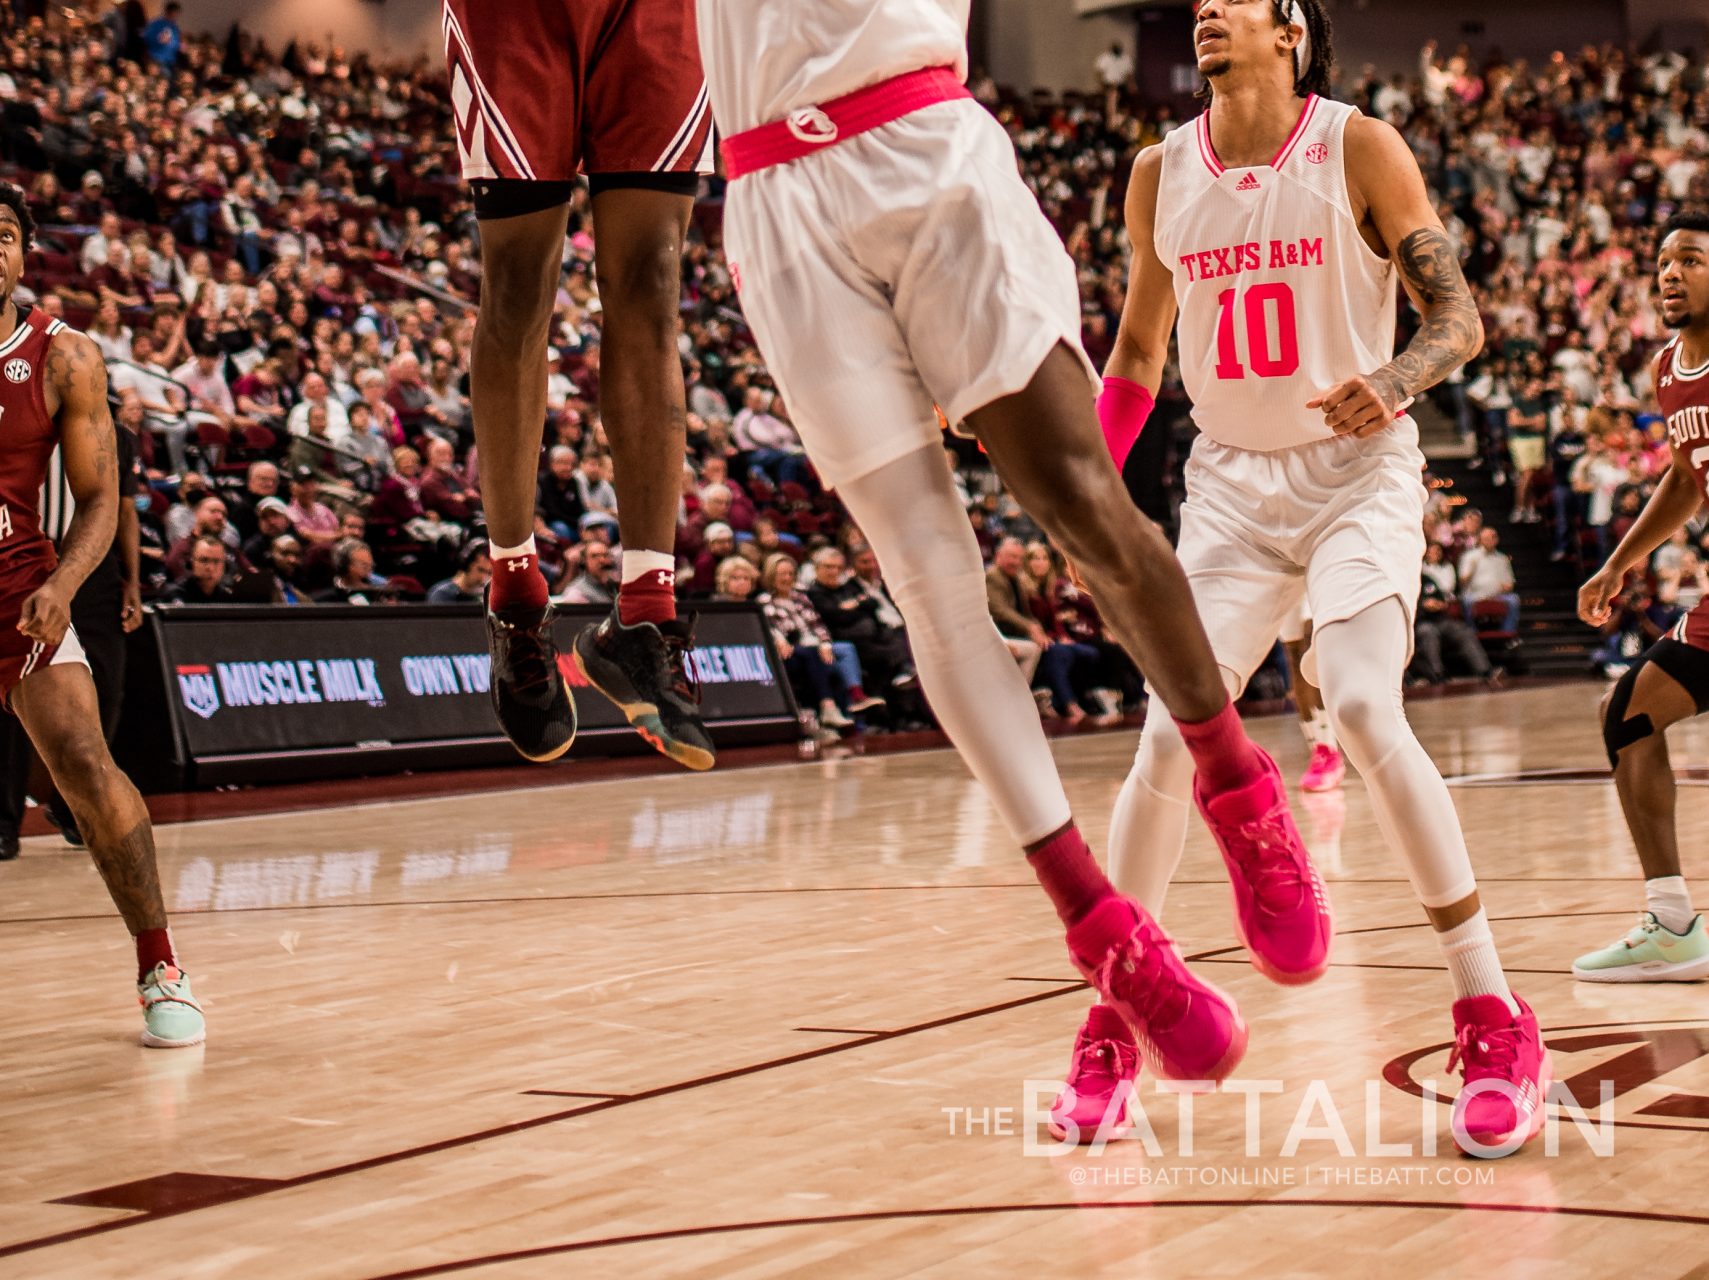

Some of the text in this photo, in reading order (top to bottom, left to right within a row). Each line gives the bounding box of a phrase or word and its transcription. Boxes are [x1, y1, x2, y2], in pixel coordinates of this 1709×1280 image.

[1235, 181, 1261, 191] adidas
[1180, 237, 1323, 282] TEXAS A&M
[1215, 282, 1300, 380] 10
[5, 360, 31, 381] SEC
[215, 659, 322, 707] MUSCLE
[316, 657, 384, 703] MILK
[401, 655, 460, 697] OWN
[723, 645, 773, 682] MILK
